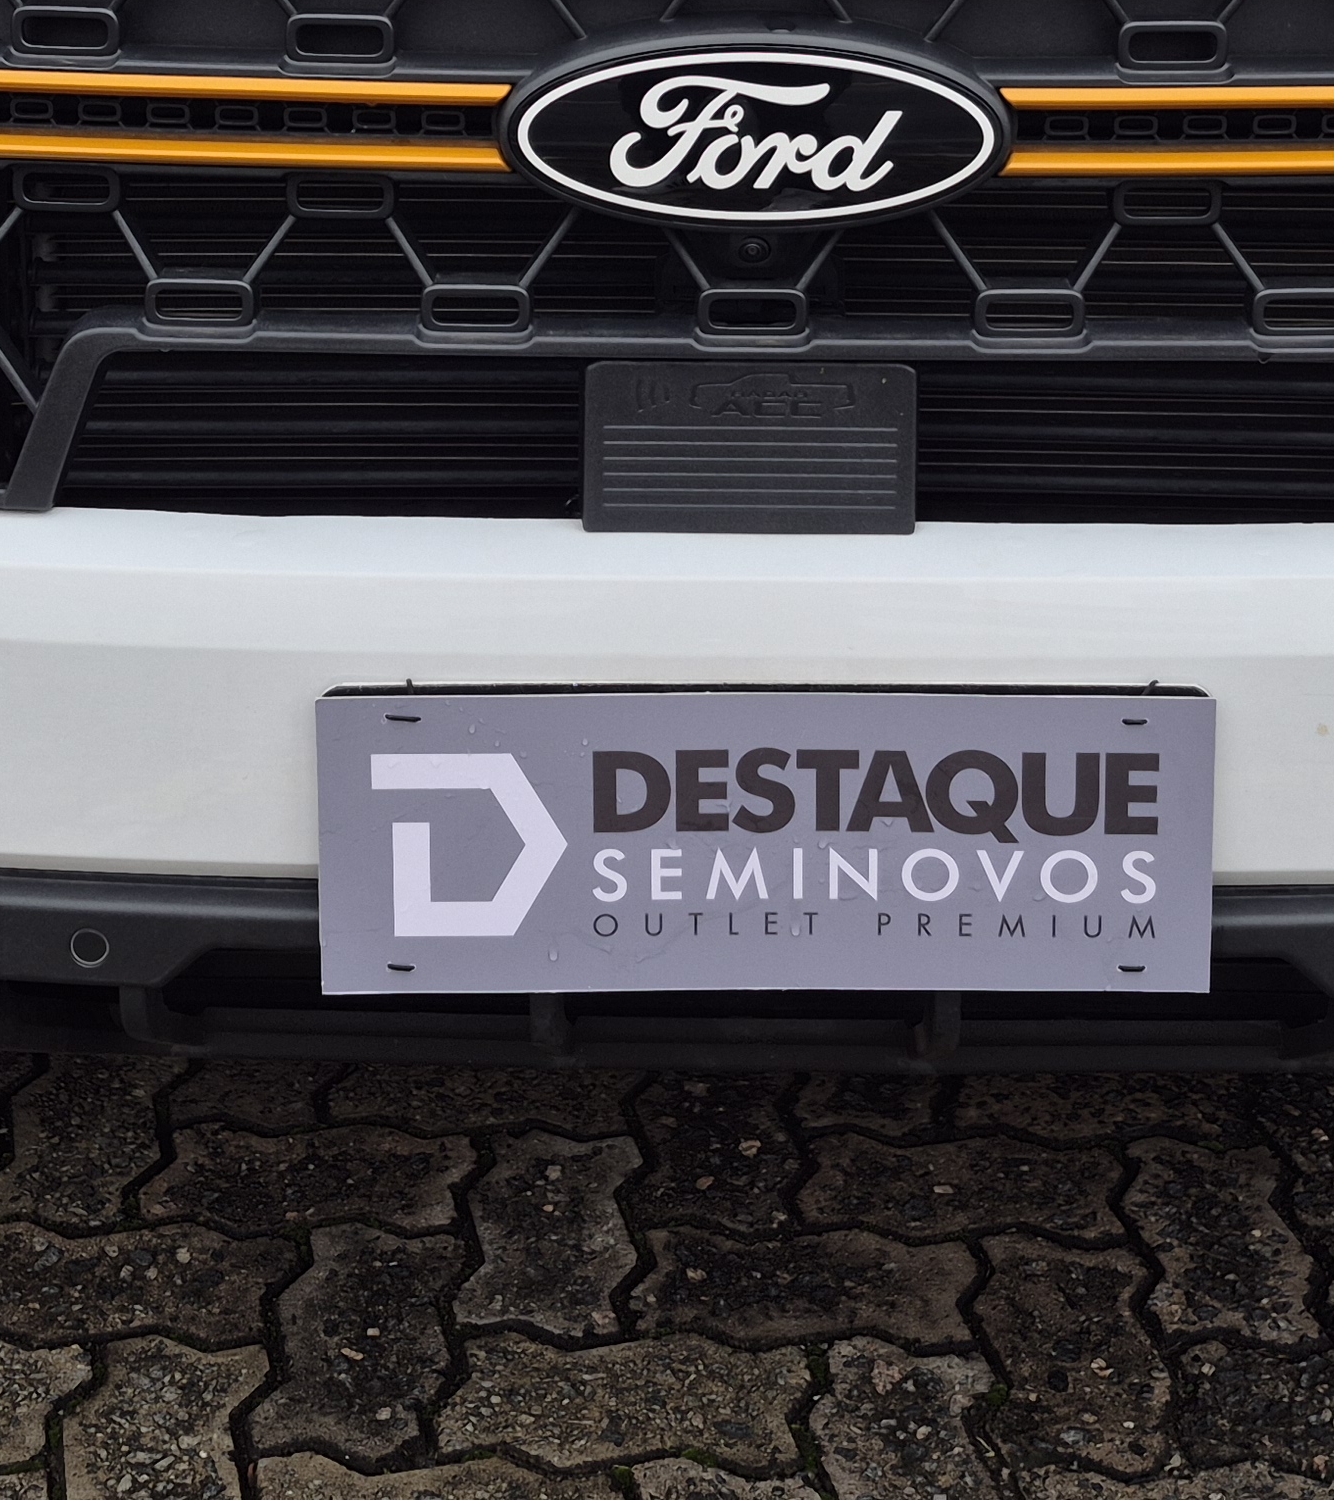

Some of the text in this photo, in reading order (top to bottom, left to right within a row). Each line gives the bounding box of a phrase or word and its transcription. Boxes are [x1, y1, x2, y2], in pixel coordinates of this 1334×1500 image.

[608, 74, 904, 193] Ford
[591, 746, 1161, 845] DESTAQUE
[591, 846, 1159, 904] SEMINOVOS
[592, 911, 1158, 940] OUTLET PREMIUM
